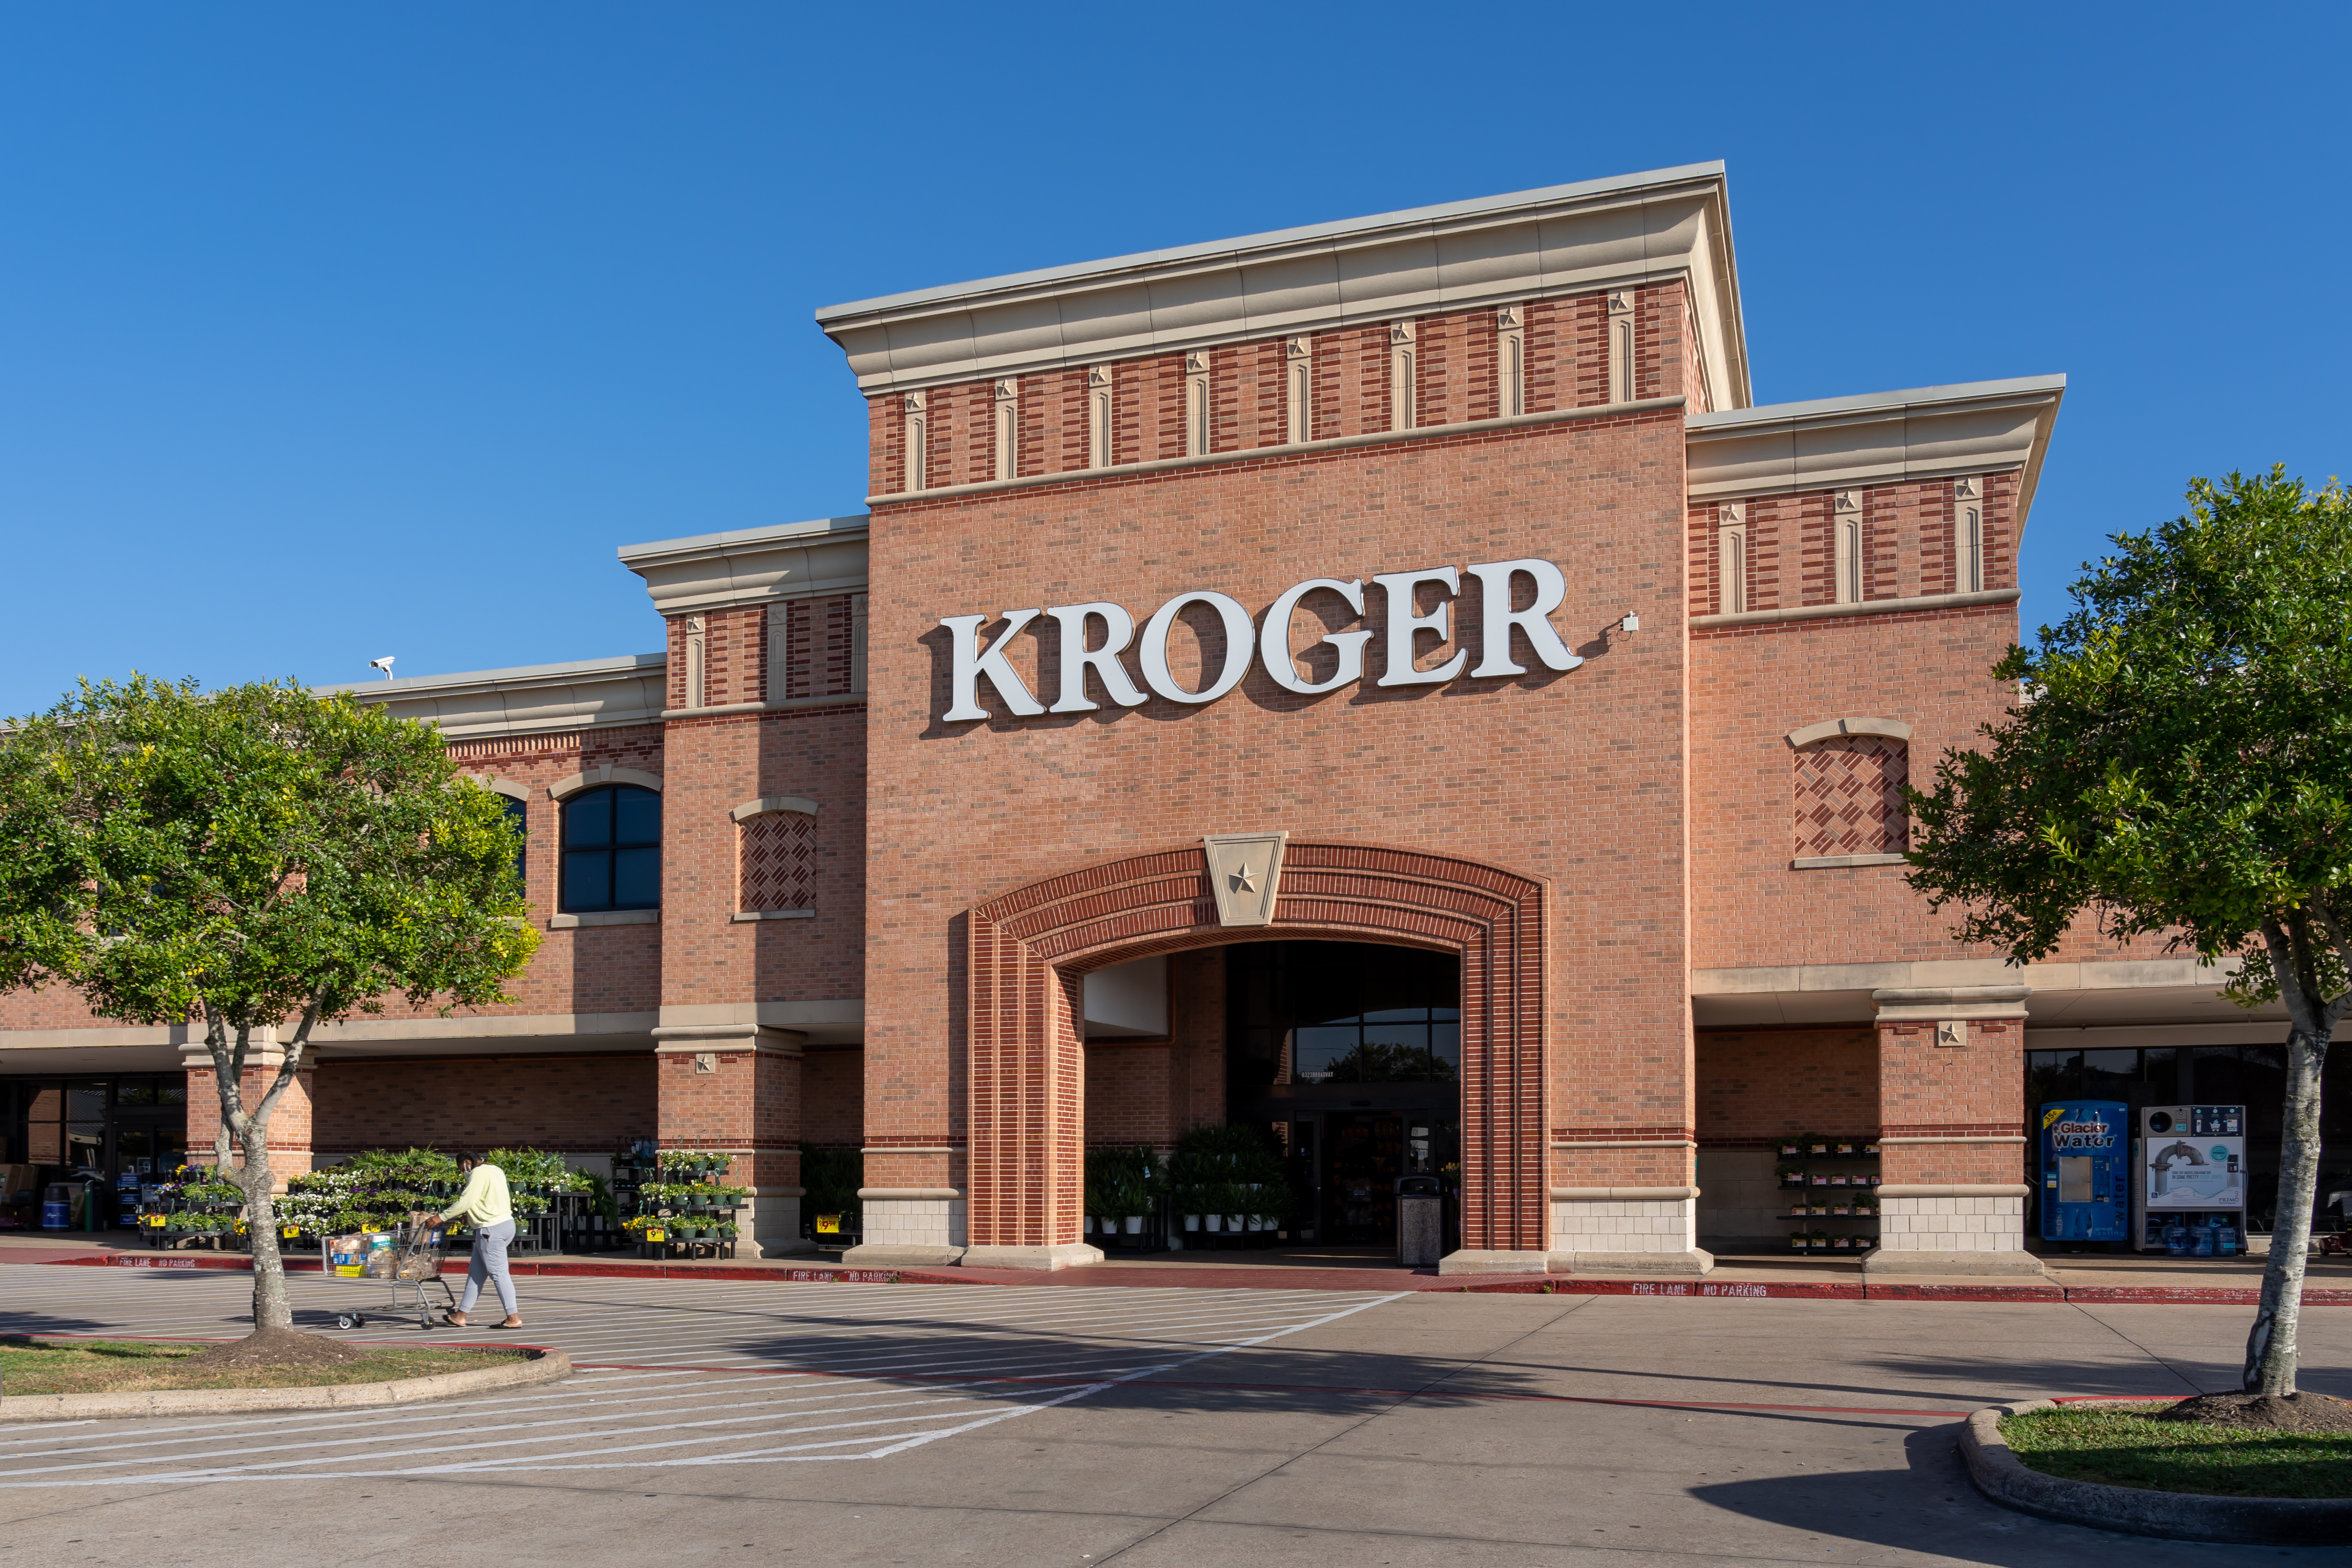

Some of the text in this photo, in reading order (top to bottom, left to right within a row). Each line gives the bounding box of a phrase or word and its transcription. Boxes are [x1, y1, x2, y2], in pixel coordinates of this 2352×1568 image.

[940, 558, 1585, 722] KROGER
[2044, 1111, 2057, 1122] 35¢
[2060, 1123, 2107, 1134] Glacier
[2053, 1134, 2114, 1147] Water
[2113, 1176, 2125, 1221] water
[2054, 1208, 2064, 1231] crisp
[120, 1257, 195, 1267] FIRE LANE NO PARKING
[793, 1270, 811, 1281] FIRE
[849, 1271, 859, 1282] NO
[1633, 1283, 1767, 1297] FIRE LANE NO PARKING
